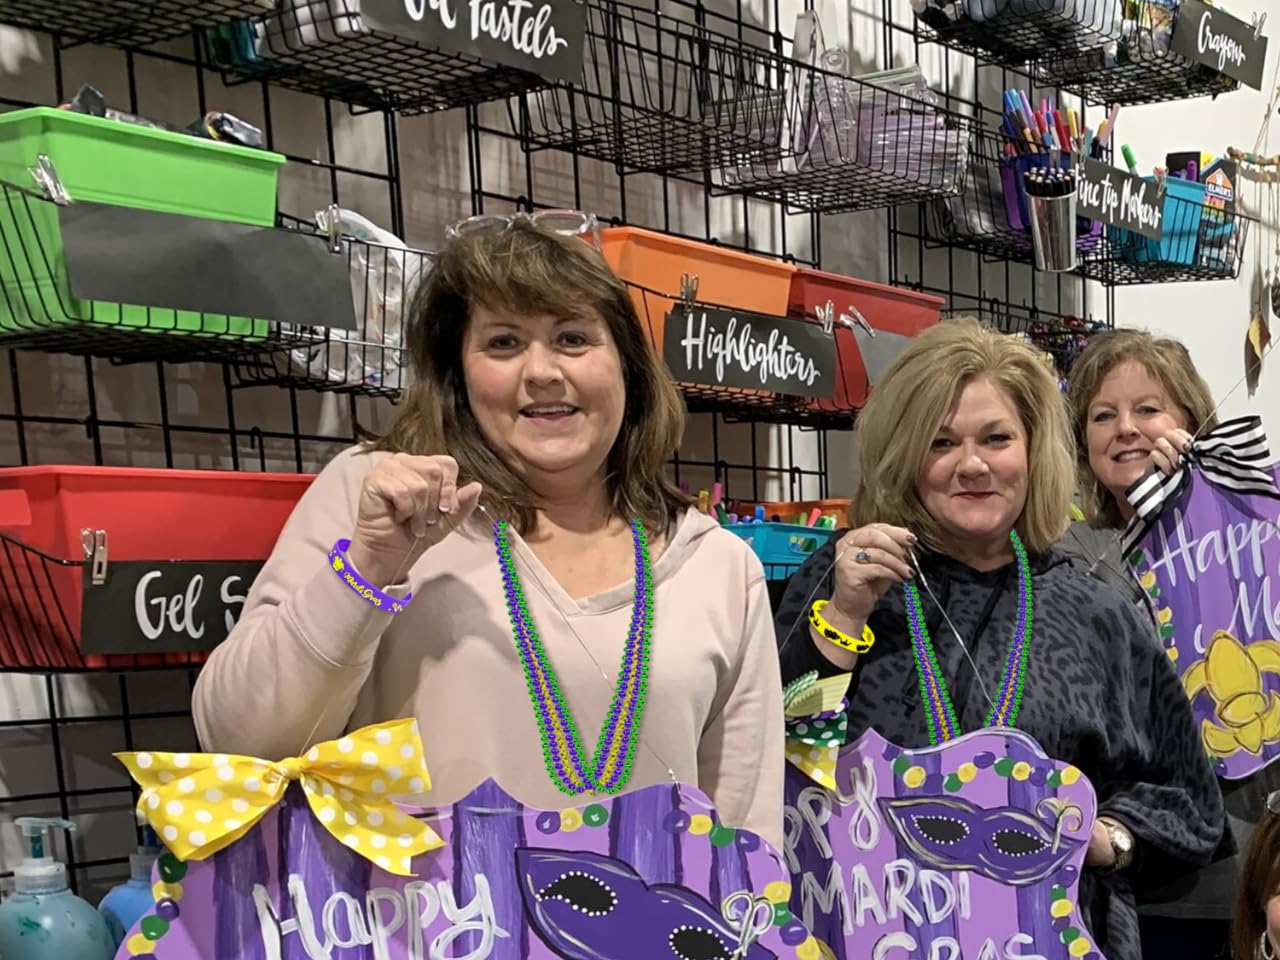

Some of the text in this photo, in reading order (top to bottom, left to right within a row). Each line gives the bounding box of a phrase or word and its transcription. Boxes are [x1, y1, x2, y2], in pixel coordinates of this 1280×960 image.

[1198, 11, 1246, 71] Crayons
[1120, 178, 1161, 229] Markers
[681, 312, 821, 386] Highlighters
[135, 570, 205, 640] Gel
[783, 756, 881, 875] ppy
[801, 858, 971, 935] MARDI
